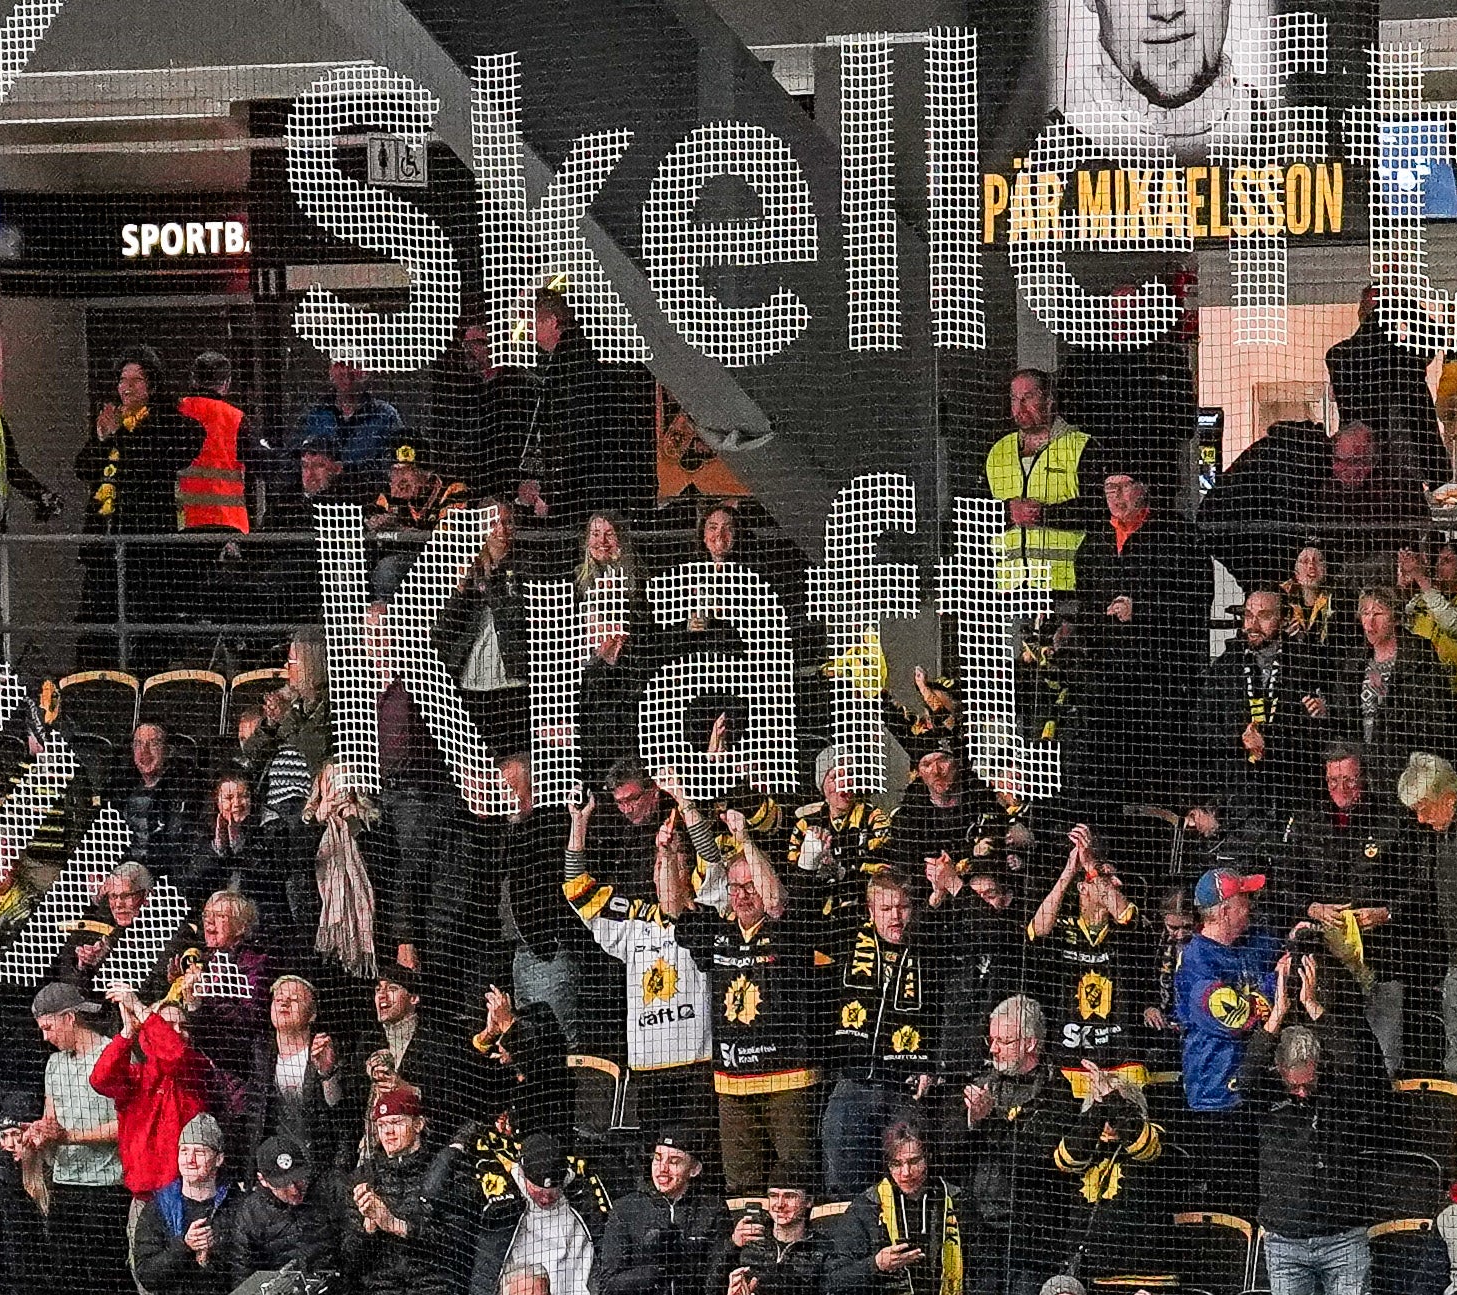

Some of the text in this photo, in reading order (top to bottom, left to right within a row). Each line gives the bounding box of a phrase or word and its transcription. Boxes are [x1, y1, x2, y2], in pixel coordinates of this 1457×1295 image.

[983, 157, 1343, 243] PÄR MIKAELSSON
[120, 221, 250, 258] SPORTB
[852, 929, 874, 978] AIK
